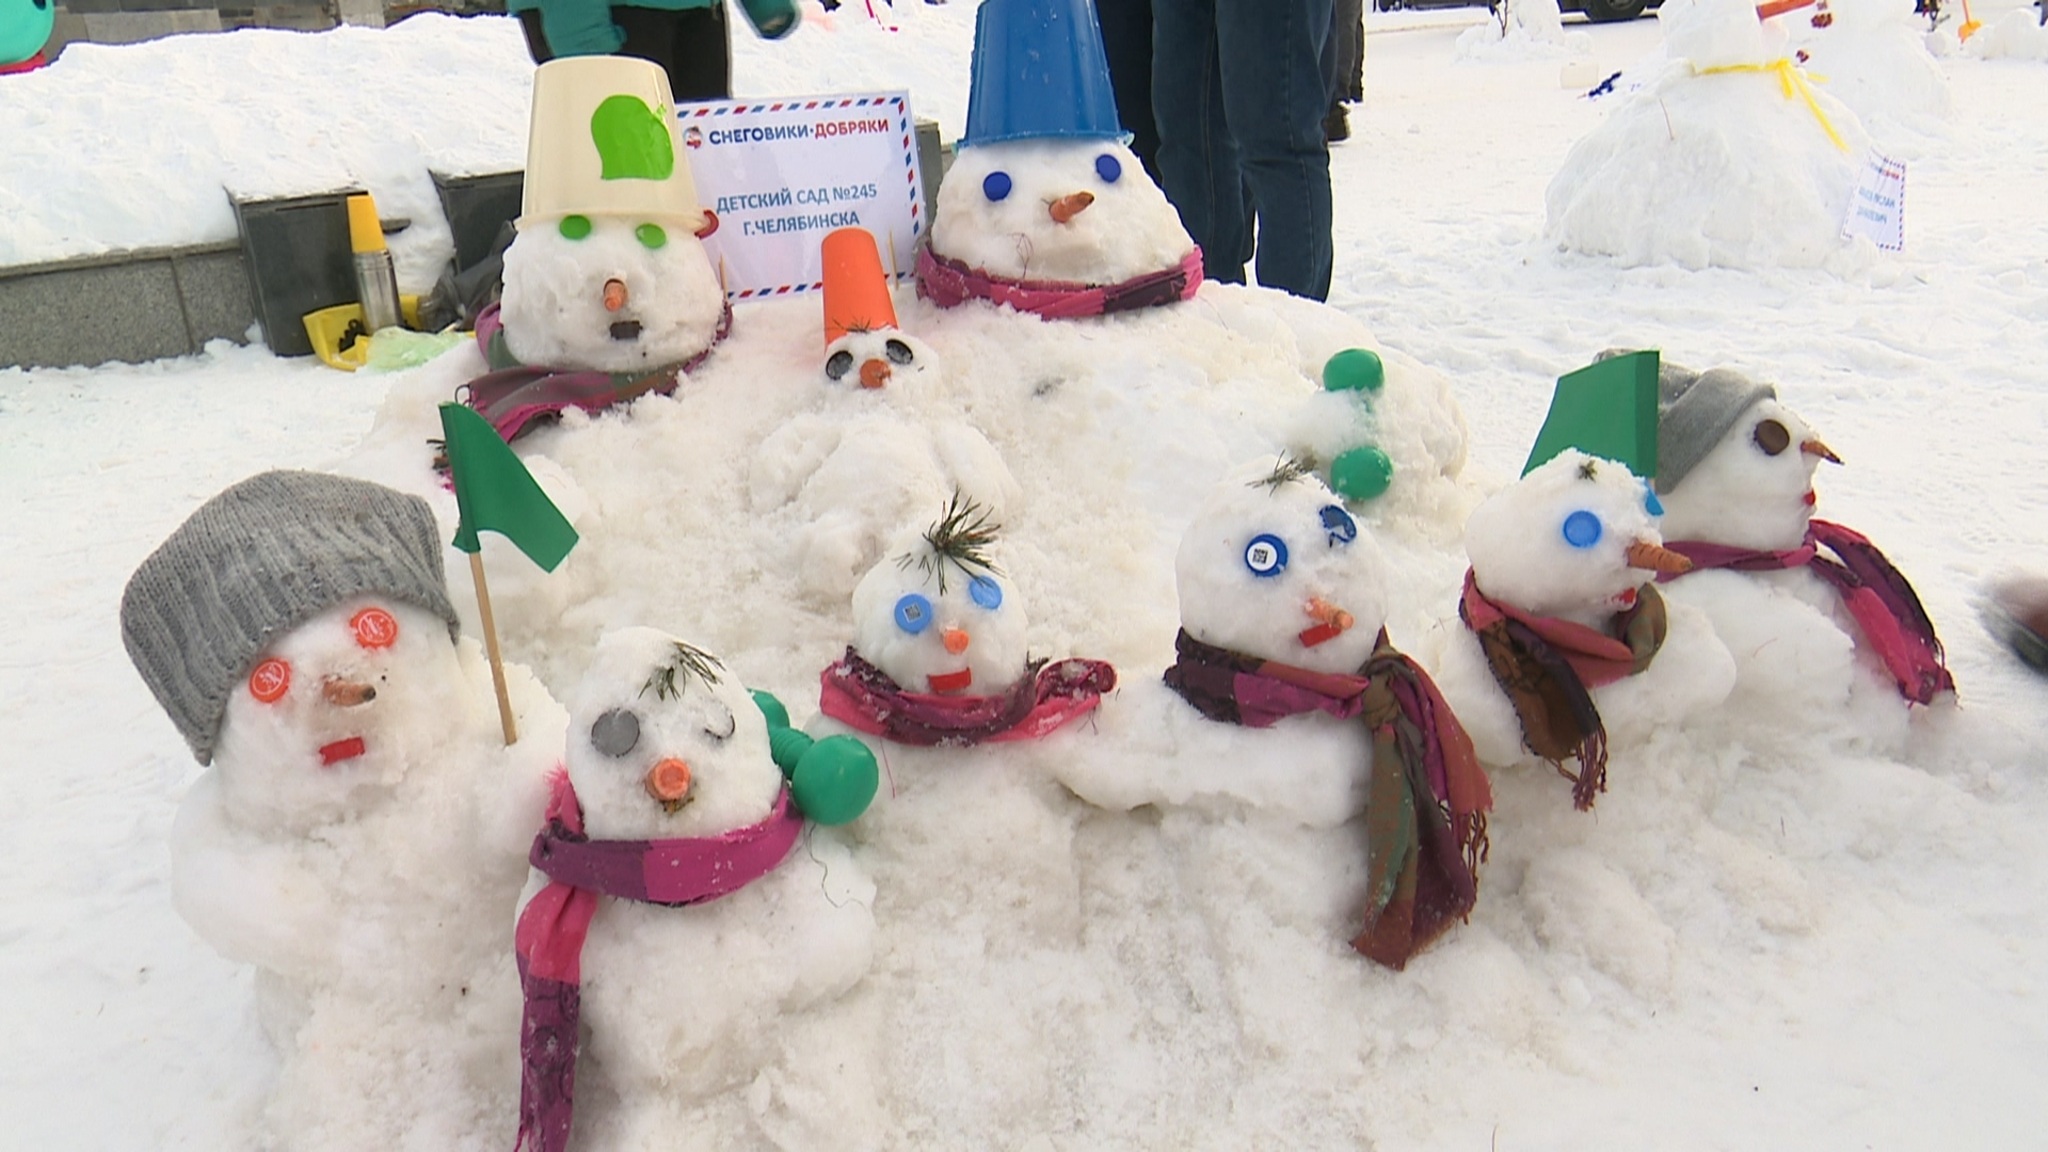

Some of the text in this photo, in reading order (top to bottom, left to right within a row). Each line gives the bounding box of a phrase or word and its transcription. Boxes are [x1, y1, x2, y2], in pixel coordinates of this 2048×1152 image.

[717, 183, 878, 215] ДЕТСКИЙ САД №245
[743, 211, 860, 236] Г.ЧЕЛЯБИНСКА
